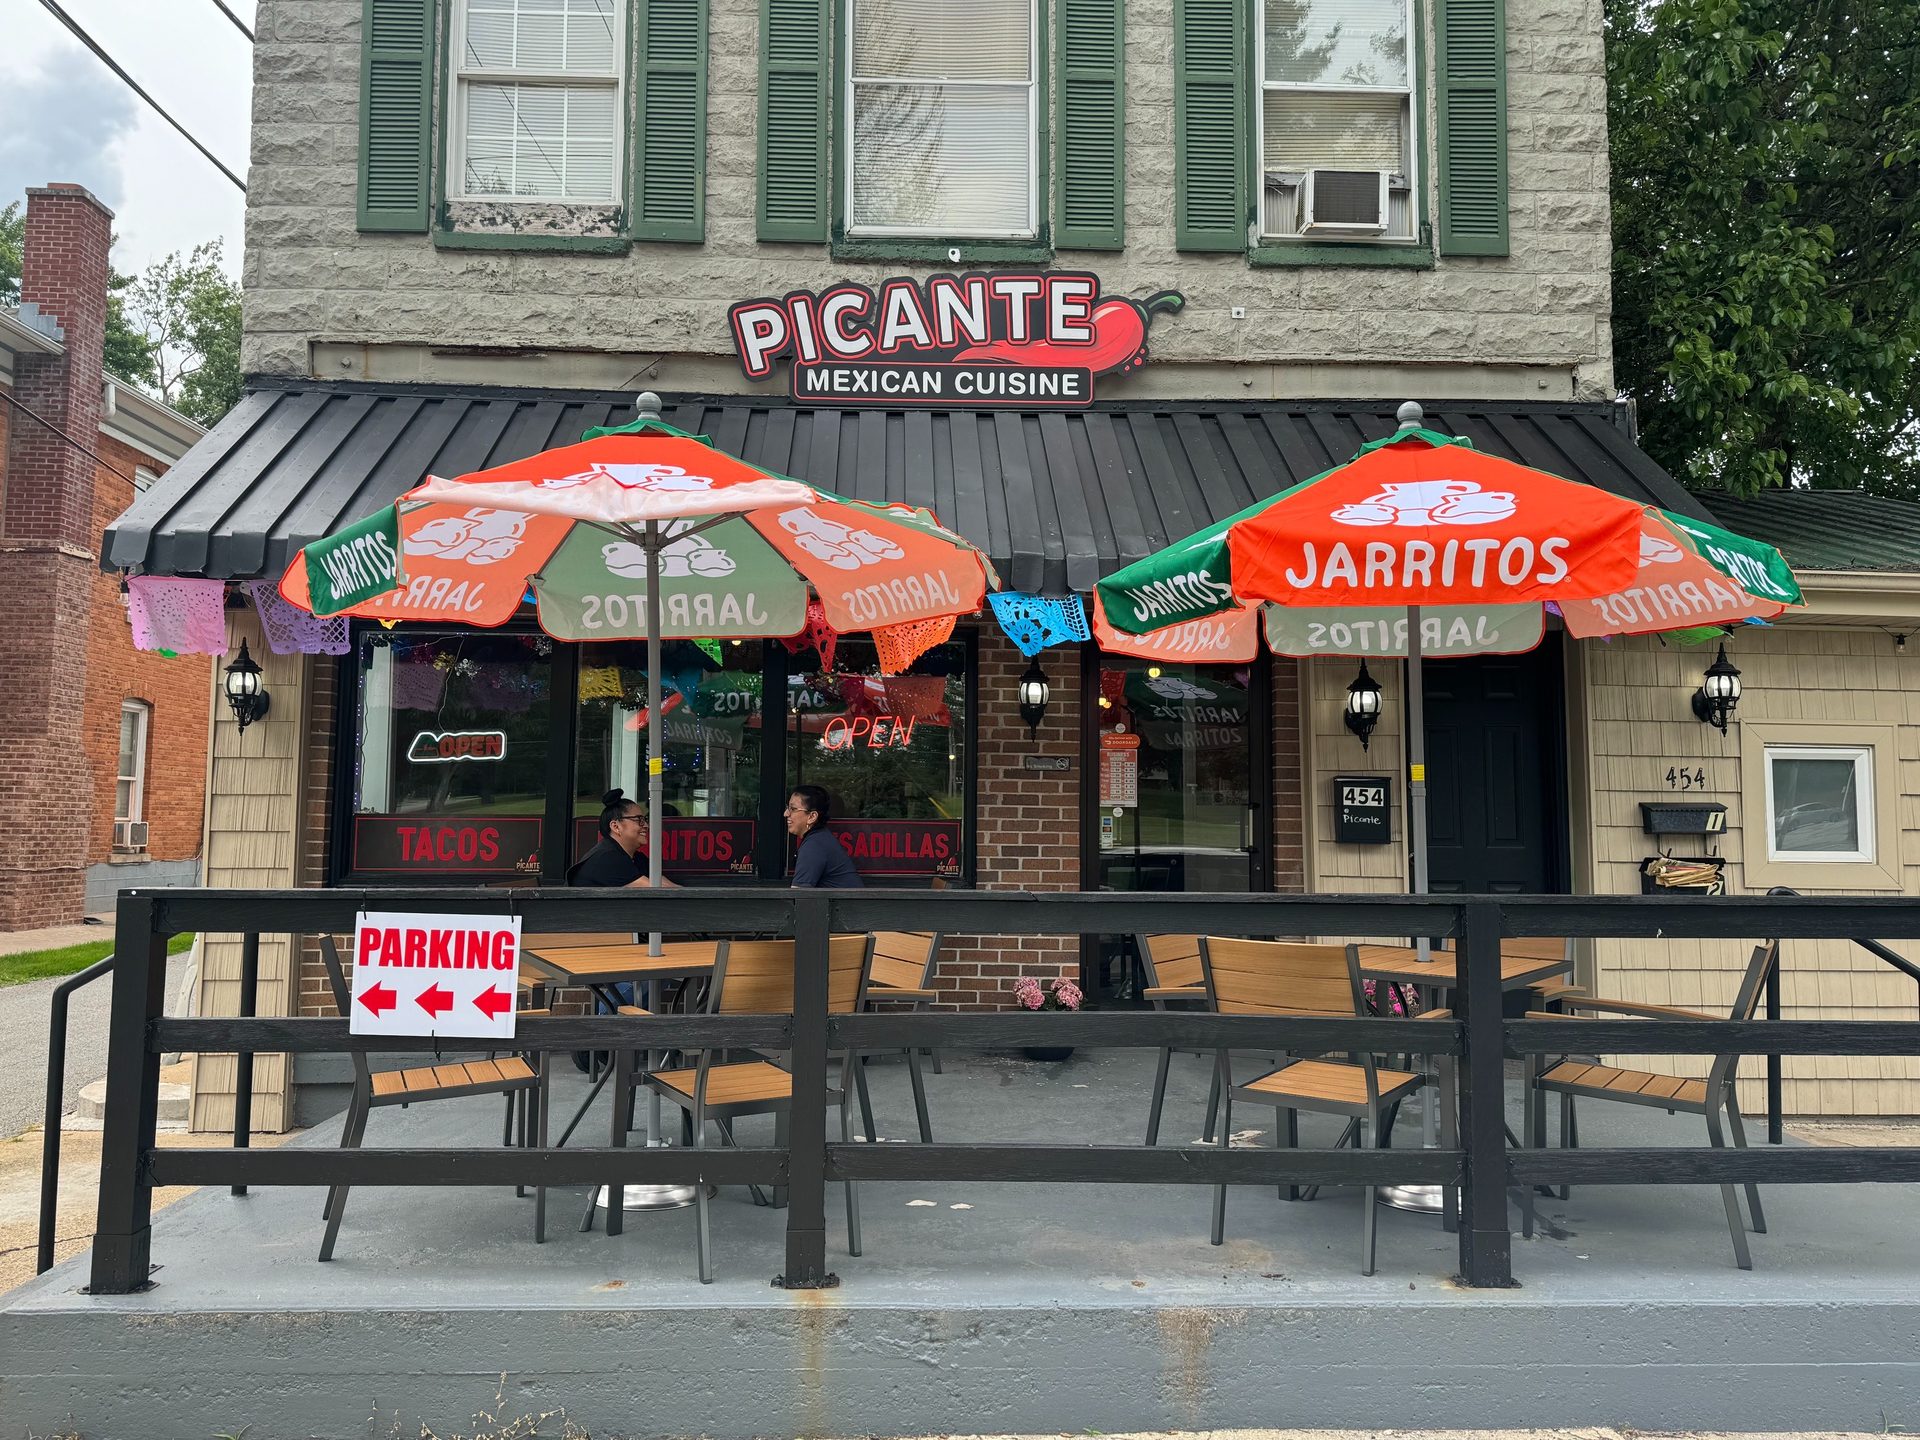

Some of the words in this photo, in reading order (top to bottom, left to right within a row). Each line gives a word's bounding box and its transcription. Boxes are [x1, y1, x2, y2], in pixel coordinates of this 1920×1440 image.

[736, 279, 1092, 373] PICANTE
[806, 368, 942, 395] MEXICAN
[953, 371, 1080, 396] CUISINE
[319, 530, 397, 601] JARRITOS
[1285, 536, 1571, 588] JARRITOS
[1124, 569, 1232, 622] JARRITOS
[438, 734, 502, 758] OPEN
[823, 715, 916, 750] OPEN
[1665, 766, 1705, 790] 454
[1344, 787, 1383, 806] 454
[1342, 814, 1382, 825] Picante
[1711, 813, 1719, 830] 1
[396, 826, 500, 862] TACOS
[642, 830, 733, 861] RITOS
[838, 832, 949, 859] SADILLAS
[516, 861, 541, 870] PICANTE
[730, 863, 754, 871] PICANTE
[936, 864, 960, 873] PICANTE
[358, 927, 515, 971] PARKING
